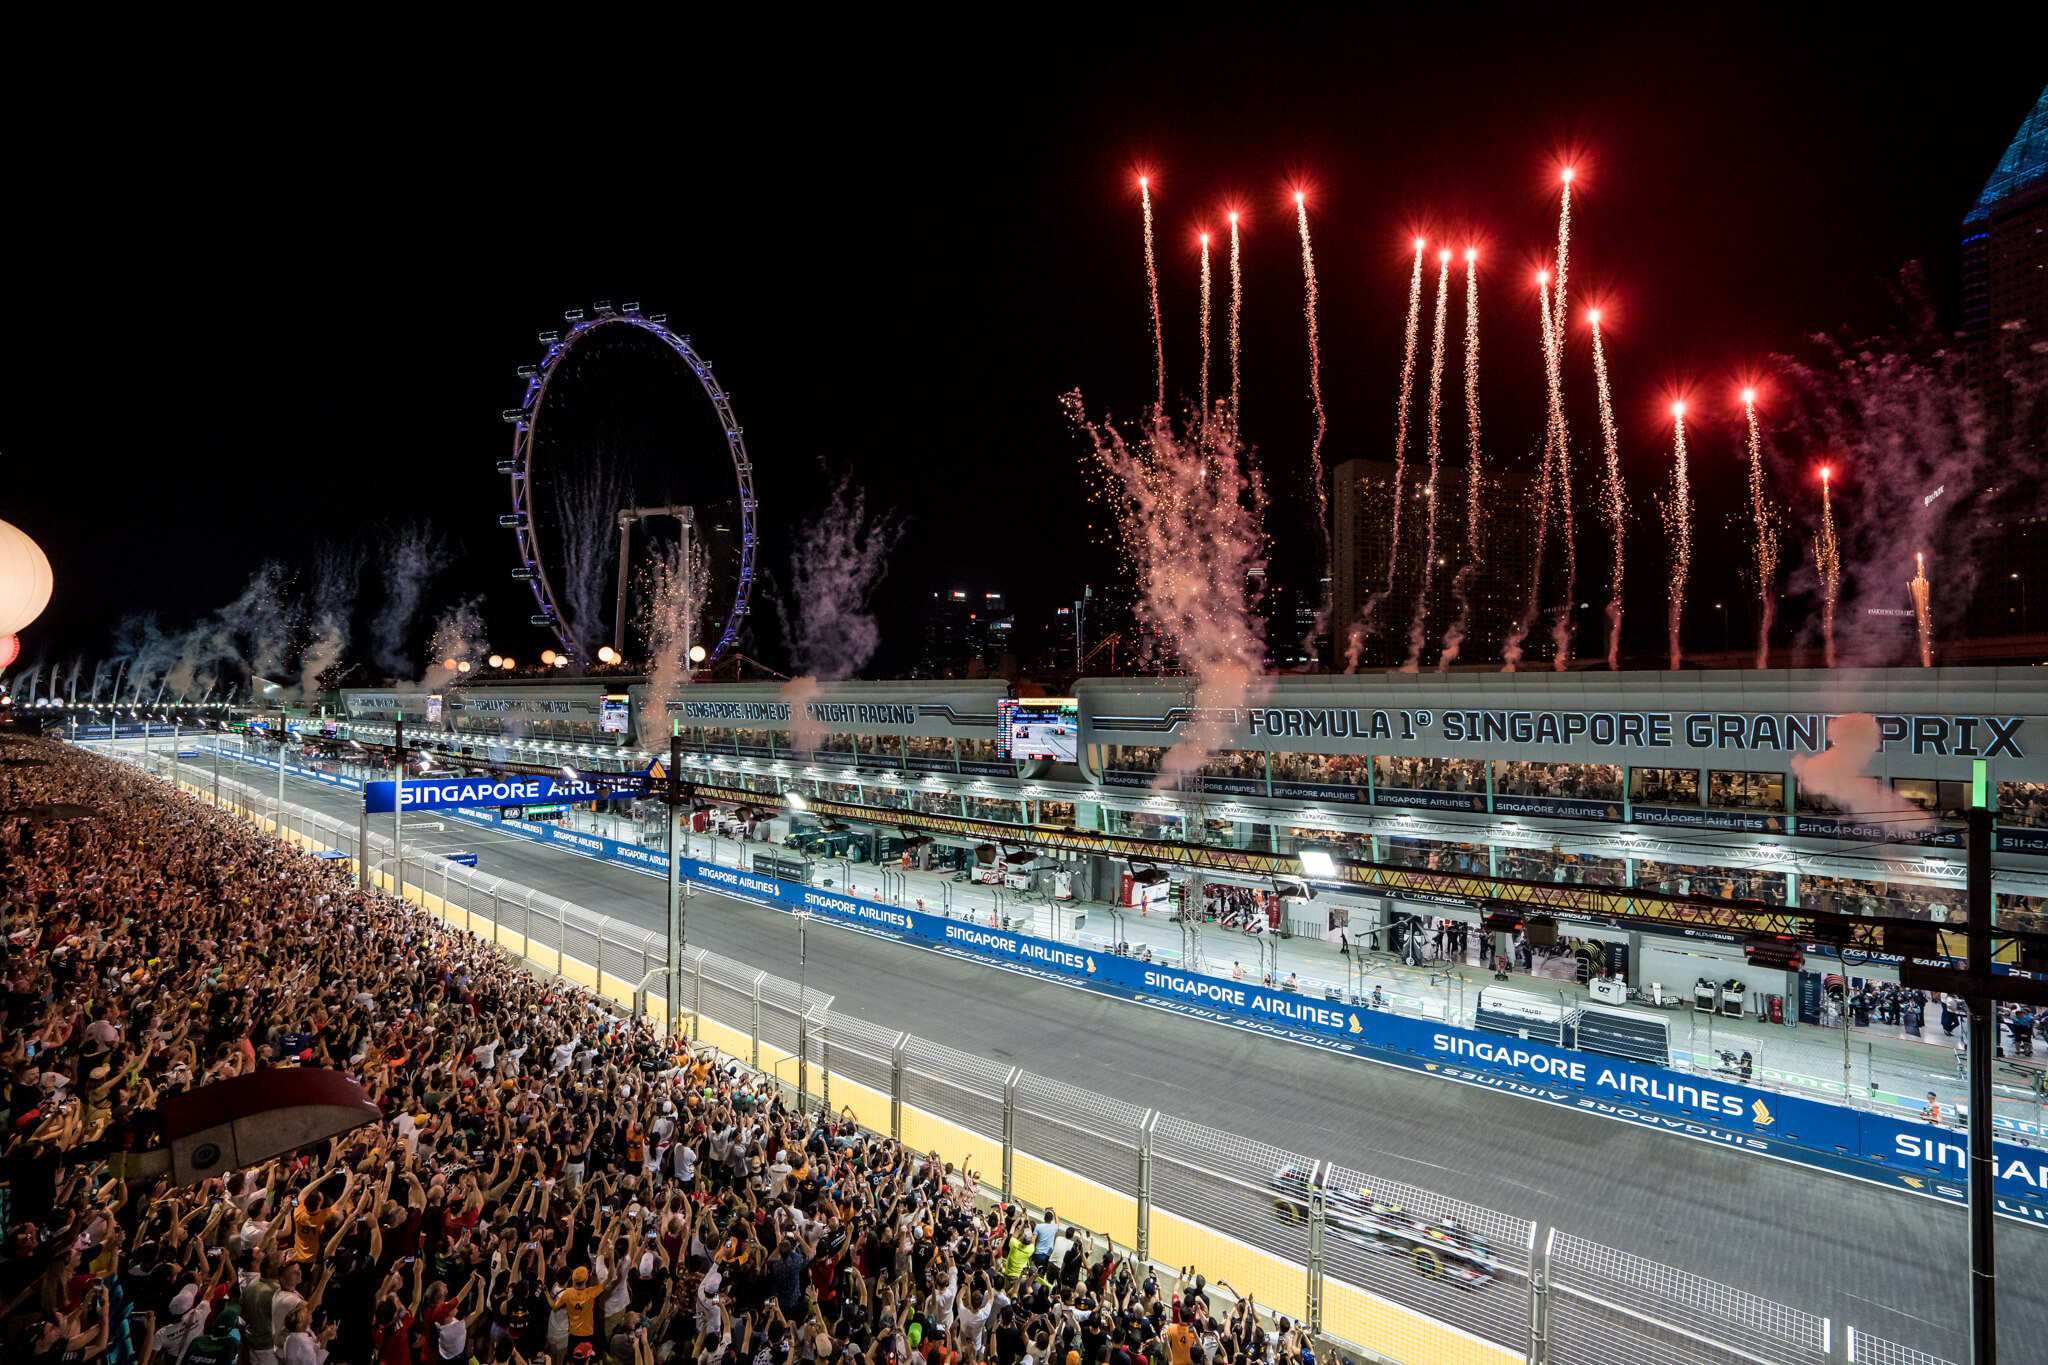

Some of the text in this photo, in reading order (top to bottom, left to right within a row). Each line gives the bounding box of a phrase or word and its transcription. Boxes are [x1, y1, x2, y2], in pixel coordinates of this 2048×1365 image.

[745, 702, 778, 720] HOME
[816, 704, 857, 722] NIGHT
[860, 705, 917, 725] RACING
[1250, 708, 1393, 740] FORMULA
[1441, 709, 1673, 748] SINGAPORE
[1876, 715, 2026, 759] PRIX
[399, 781, 539, 805] SINGAPORE
[1224, 785, 1255, 793] AIRLINES
[1274, 788, 1356, 800] SINGAPORE AIRLINES
[1377, 795, 1471, 808] SINGAPORE AIRLINES
[1496, 802, 1605, 817] SINGAPORE AIRLINES
[504, 809, 519, 818] FIA
[1635, 812, 1763, 828] SINGAPORE AIRLINES
[553, 830, 600, 850] SINGAPORE AIRLINES
[1799, 823, 1881, 837] SINGAPORE
[617, 846, 670, 867] SINGAPORE AIRLIN
[698, 866, 737, 885] SINGAPORE
[739, 876, 774, 895] AIRLINES
[804, 892, 856, 915] SINGAPORE
[858, 905, 905, 927] AIRLINES
[1553, 911, 1592, 921] LAWSON
[1695, 930, 1735, 941] ALPHATAURI
[946, 925, 1084, 969] SINGAPORE AIRLINES
[1879, 953, 1950, 968] SAREANT
[1144, 970, 1345, 1029] SINGAPORE AIRLINES
[1145, 998, 1356, 1051] SINGAPORE AIRLINES
[1433, 1032, 1744, 1117] SINGAPORE AIRLINES
[1441, 1066, 1769, 1150] SINGAPORE AIRLINES
[1895, 1133, 2048, 1189] SINA
[1180, 1335, 1187, 1345] 4
